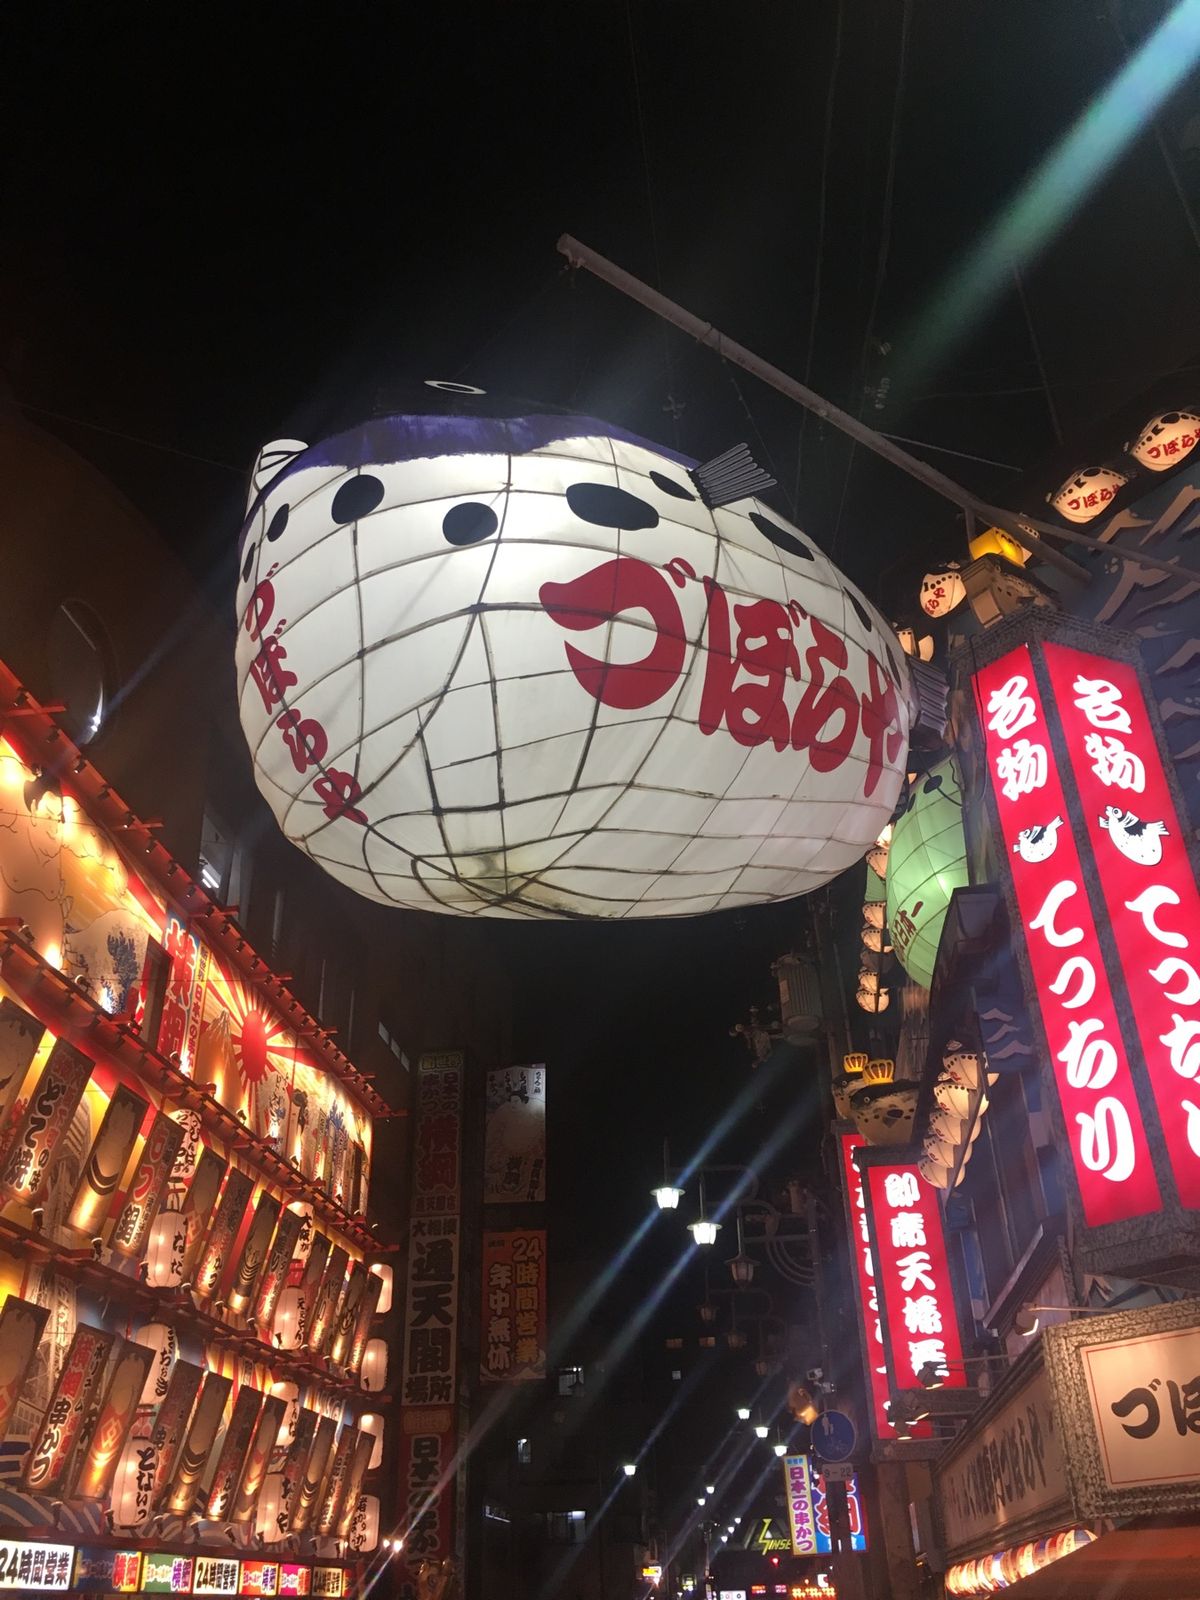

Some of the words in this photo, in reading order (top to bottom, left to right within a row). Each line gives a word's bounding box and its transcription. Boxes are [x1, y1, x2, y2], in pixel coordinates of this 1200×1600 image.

[244, 562, 368, 825] づぼらや
[539, 556, 903, 797] づぼらや
[1072, 674, 1146, 793] 名物
[987, 675, 1047, 801] 名物
[1029, 880, 1135, 1182] てっちり
[409, 1239, 455, 1374] 通天閣
[487, 1262, 513, 1372] 年中無休
[512, 1236, 544, 1364] 24時間営業
[405, 1375, 452, 1404] 場所
[0, 1547, 70, 1586] 24時間営業
[790, 1466, 814, 1552] 日本一の串かつ
[196, 1562, 237, 1590] 24時間営業
